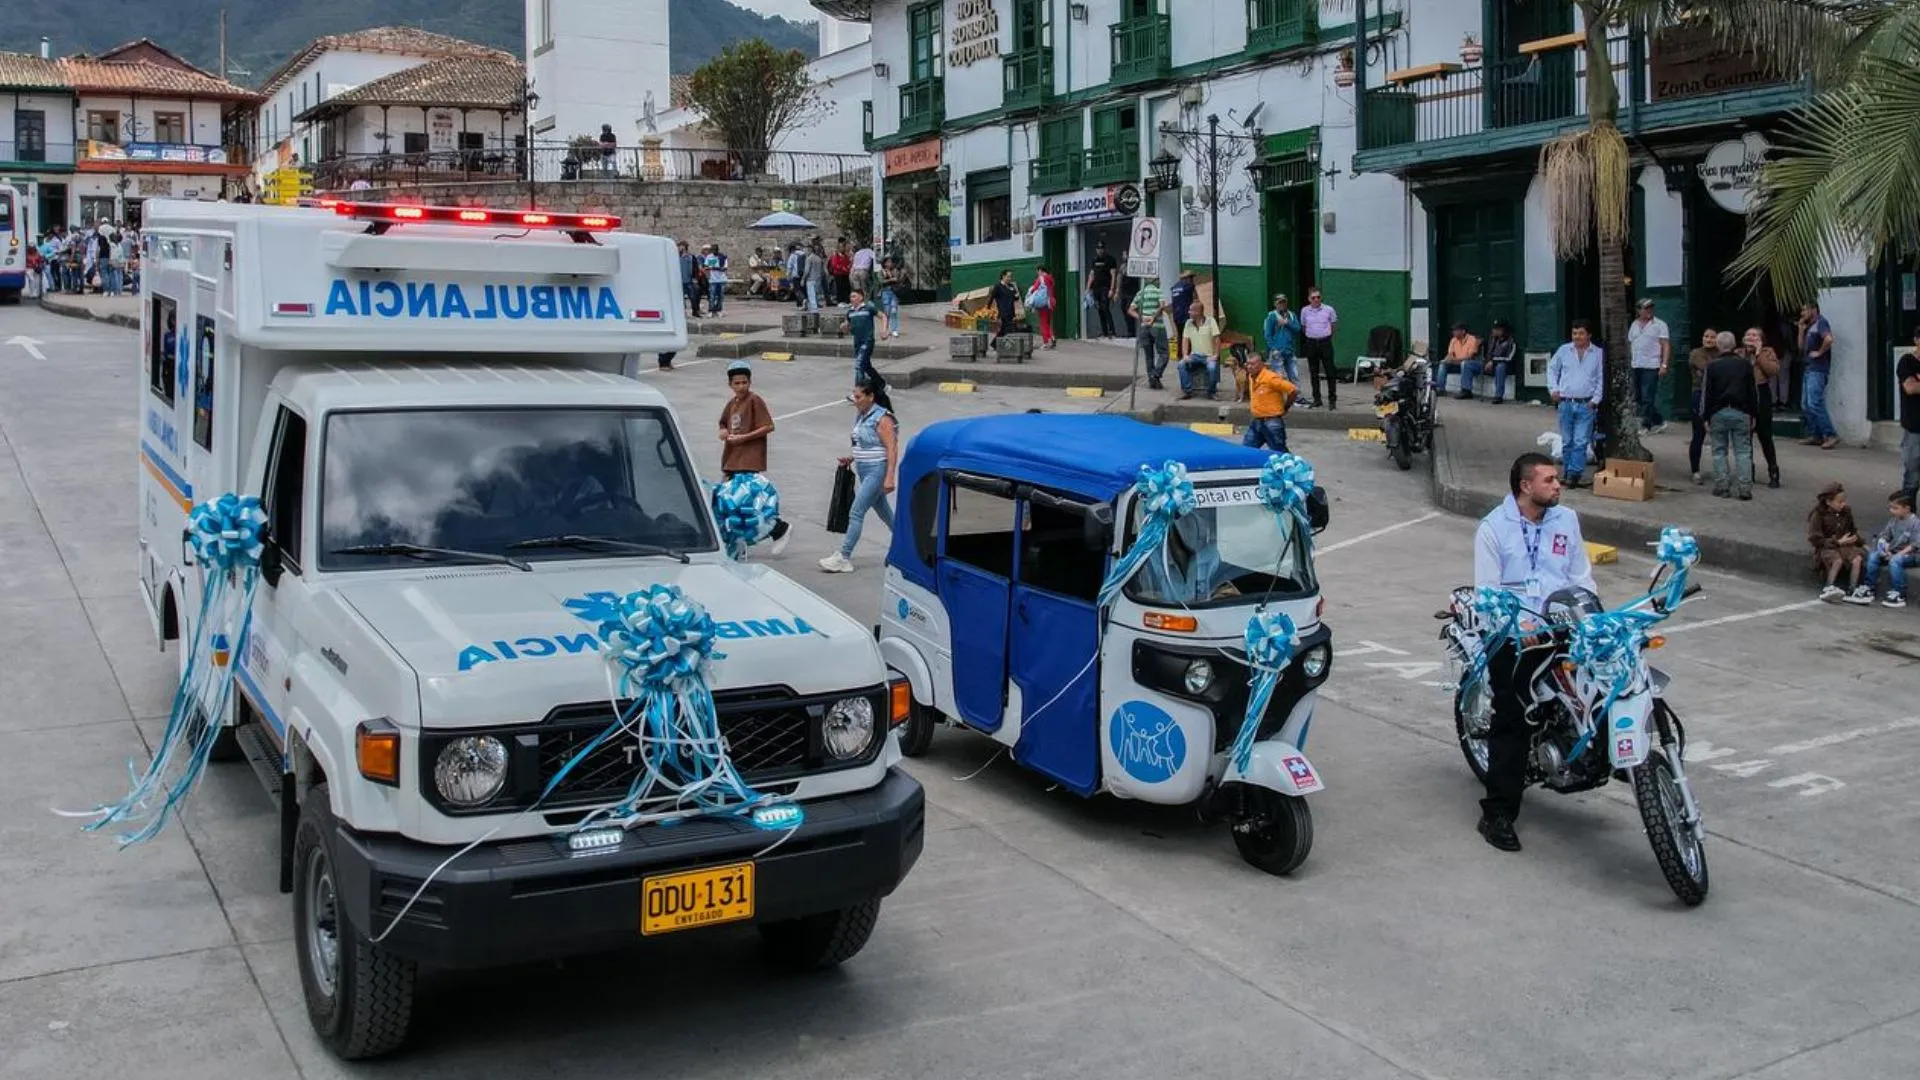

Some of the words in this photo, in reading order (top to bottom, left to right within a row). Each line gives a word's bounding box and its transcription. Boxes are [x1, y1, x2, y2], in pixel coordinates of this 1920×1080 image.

[1657, 80, 1701, 97] Zona
[1196, 488, 1229, 506] pital
[1233, 490, 1251, 501] en
[675, 909, 724, 925] ENVIGADO
